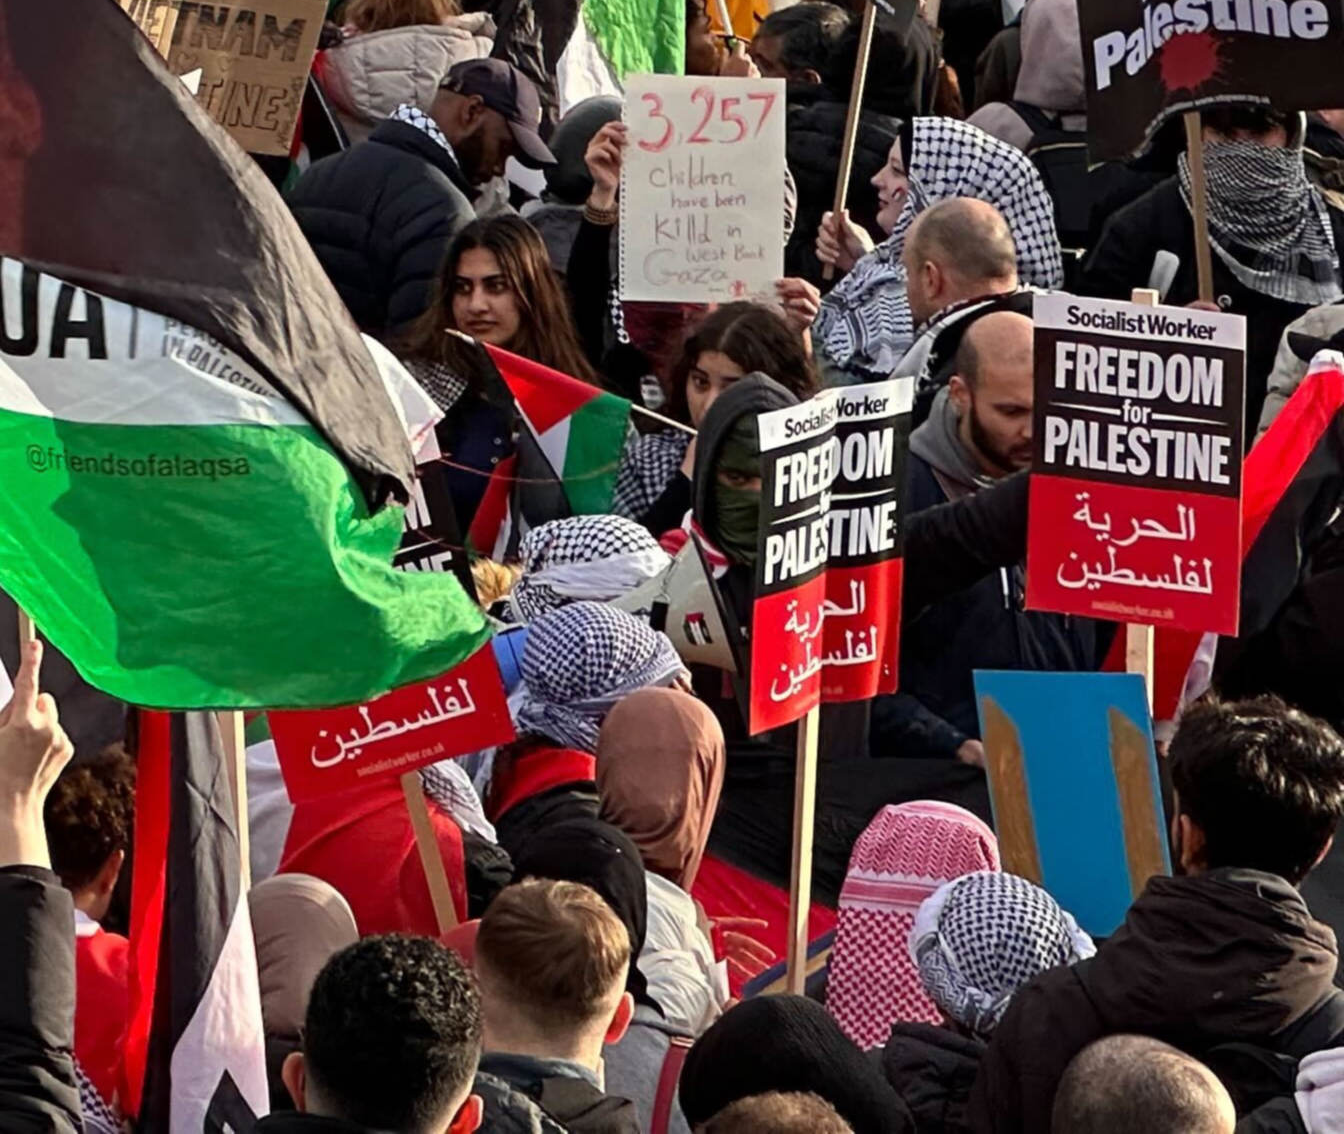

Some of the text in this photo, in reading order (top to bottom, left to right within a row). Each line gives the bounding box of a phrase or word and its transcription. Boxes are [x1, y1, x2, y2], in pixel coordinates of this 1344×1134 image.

[637, 85, 779, 153] 3,257
[649, 152, 736, 190] Children
[671, 188, 746, 210] have been
[727, 225, 743, 239] in
[643, 248, 729, 287] Gaza
[685, 246, 726, 263] West
[1068, 304, 1217, 341] Socialist Worker
[1055, 340, 1224, 407] FREEDOM
[1122, 397, 1152, 424] for
[25, 442, 252, 483] @friendsofalaqsa
[773, 427, 895, 507] FREEDOM
[1043, 416, 1231, 485] PALESTINE
[763, 501, 897, 585] PALESTINE
